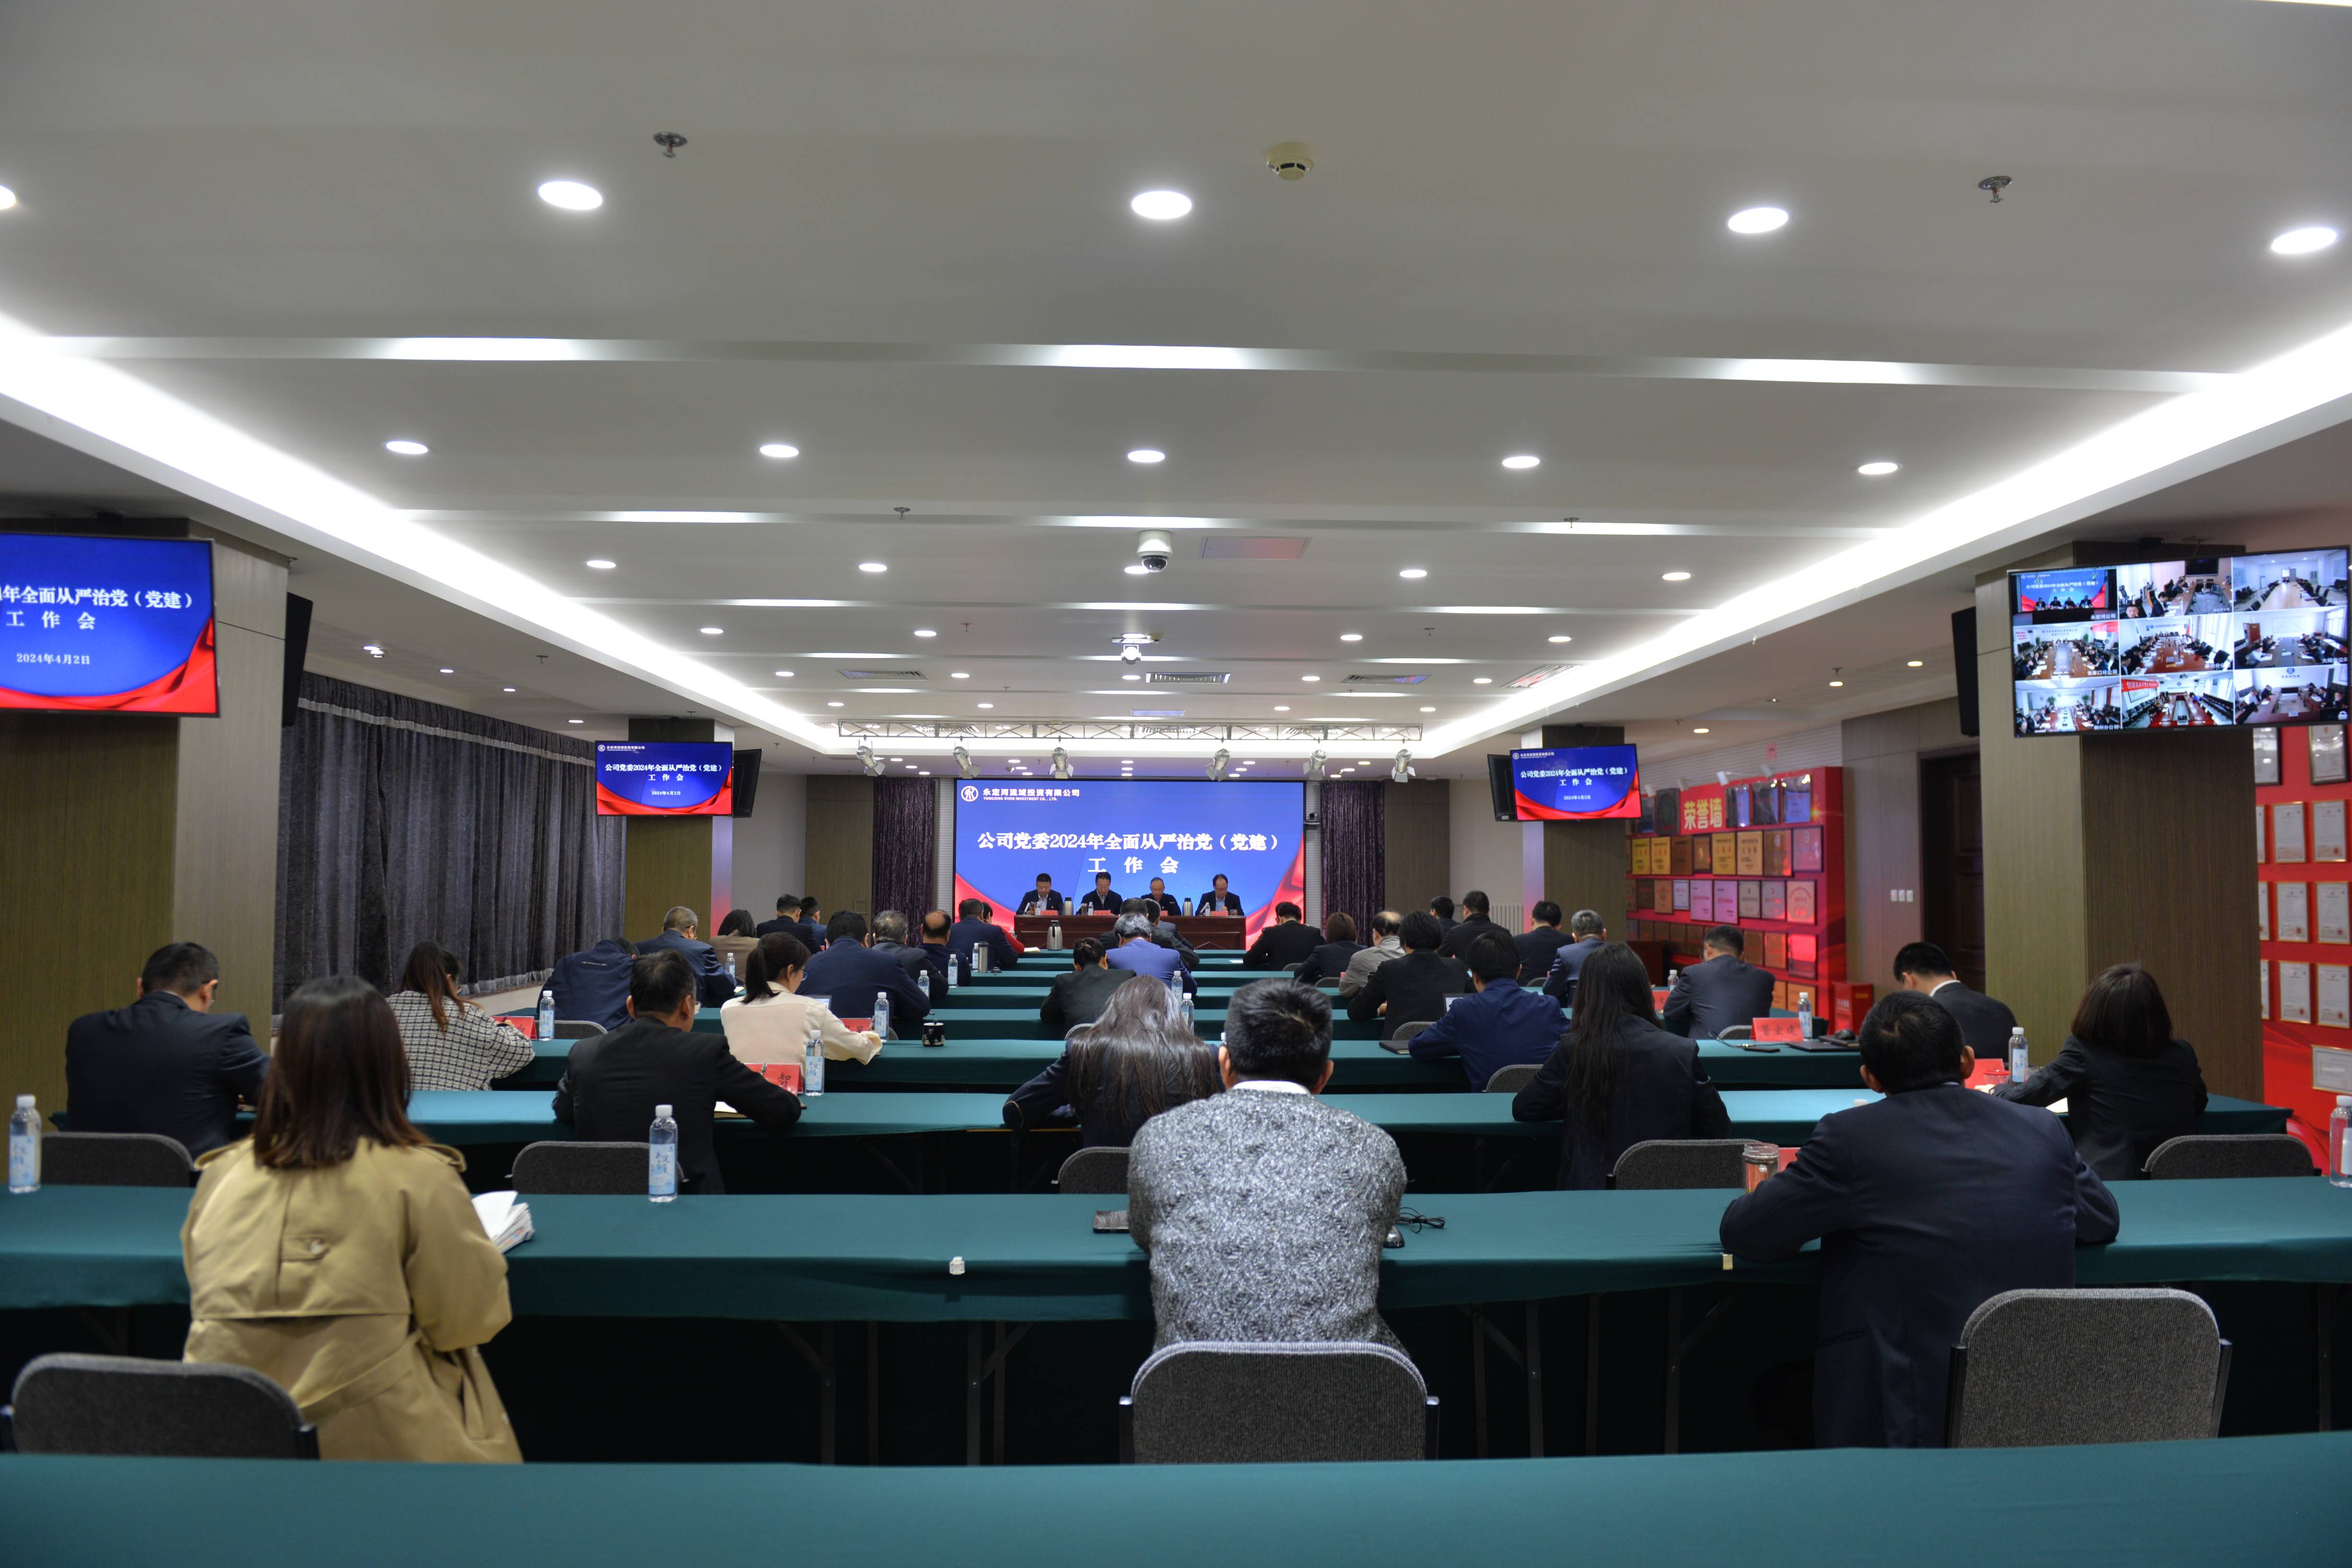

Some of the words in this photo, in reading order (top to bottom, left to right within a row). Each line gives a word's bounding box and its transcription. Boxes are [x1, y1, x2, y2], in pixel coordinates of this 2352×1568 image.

[16, 653, 91, 665] 2024年4月2日
[1684, 798, 1722, 830] 荣誉墙
[977, 832, 1280, 851] 公司党委2024年全面从严治党（党建）
